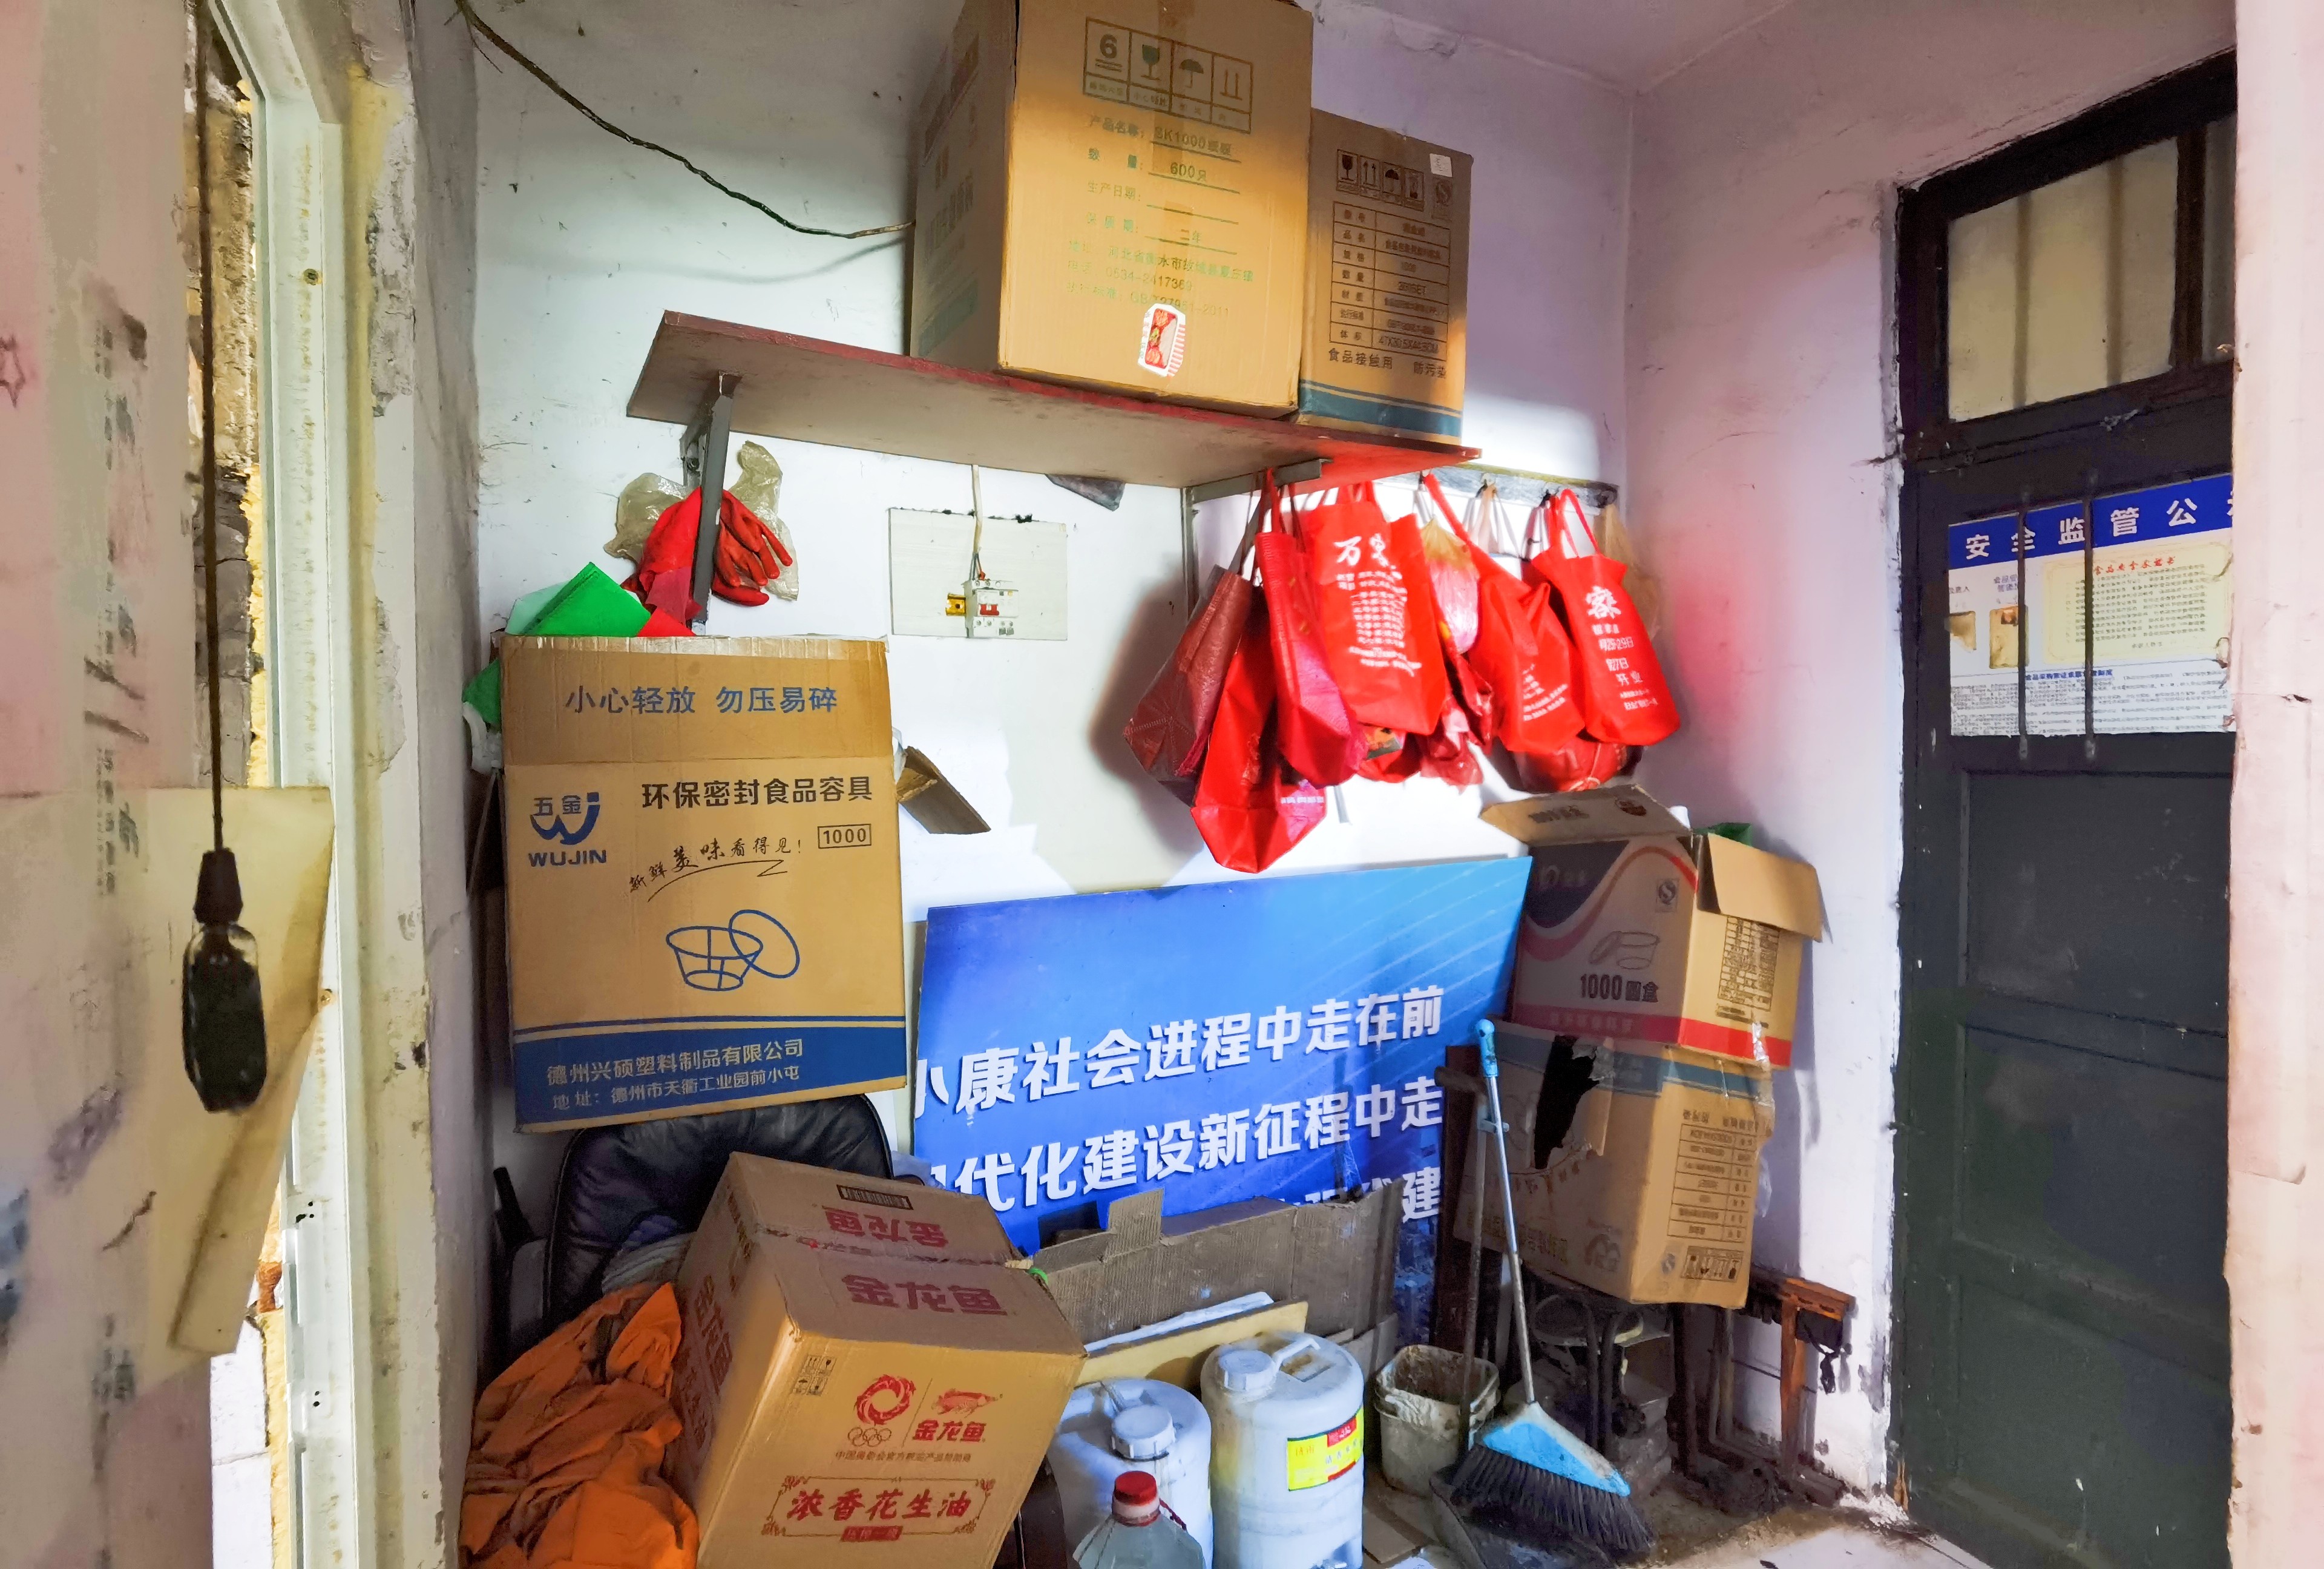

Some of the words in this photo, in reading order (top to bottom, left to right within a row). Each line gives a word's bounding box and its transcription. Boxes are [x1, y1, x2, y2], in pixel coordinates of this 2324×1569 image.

[1965, 493, 2233, 561] 安全监管公
[565, 686, 696, 713] 小心轻放
[716, 686, 838, 713] 勿压易碎
[533, 795, 582, 816] 五金
[642, 776, 872, 809] 环保密封食品容具
[822, 827, 867, 846] 1000
[528, 849, 606, 867] WUJIN
[547, 1038, 803, 1086] 德州兴硕塑料制品有限公司
[823, 1206, 948, 1248] 金龙鱼
[842, 1274, 1008, 1316] 金龙鱼
[913, 1420, 986, 1442] 金龙鱼
[787, 1488, 972, 1523] 浓香花生油
